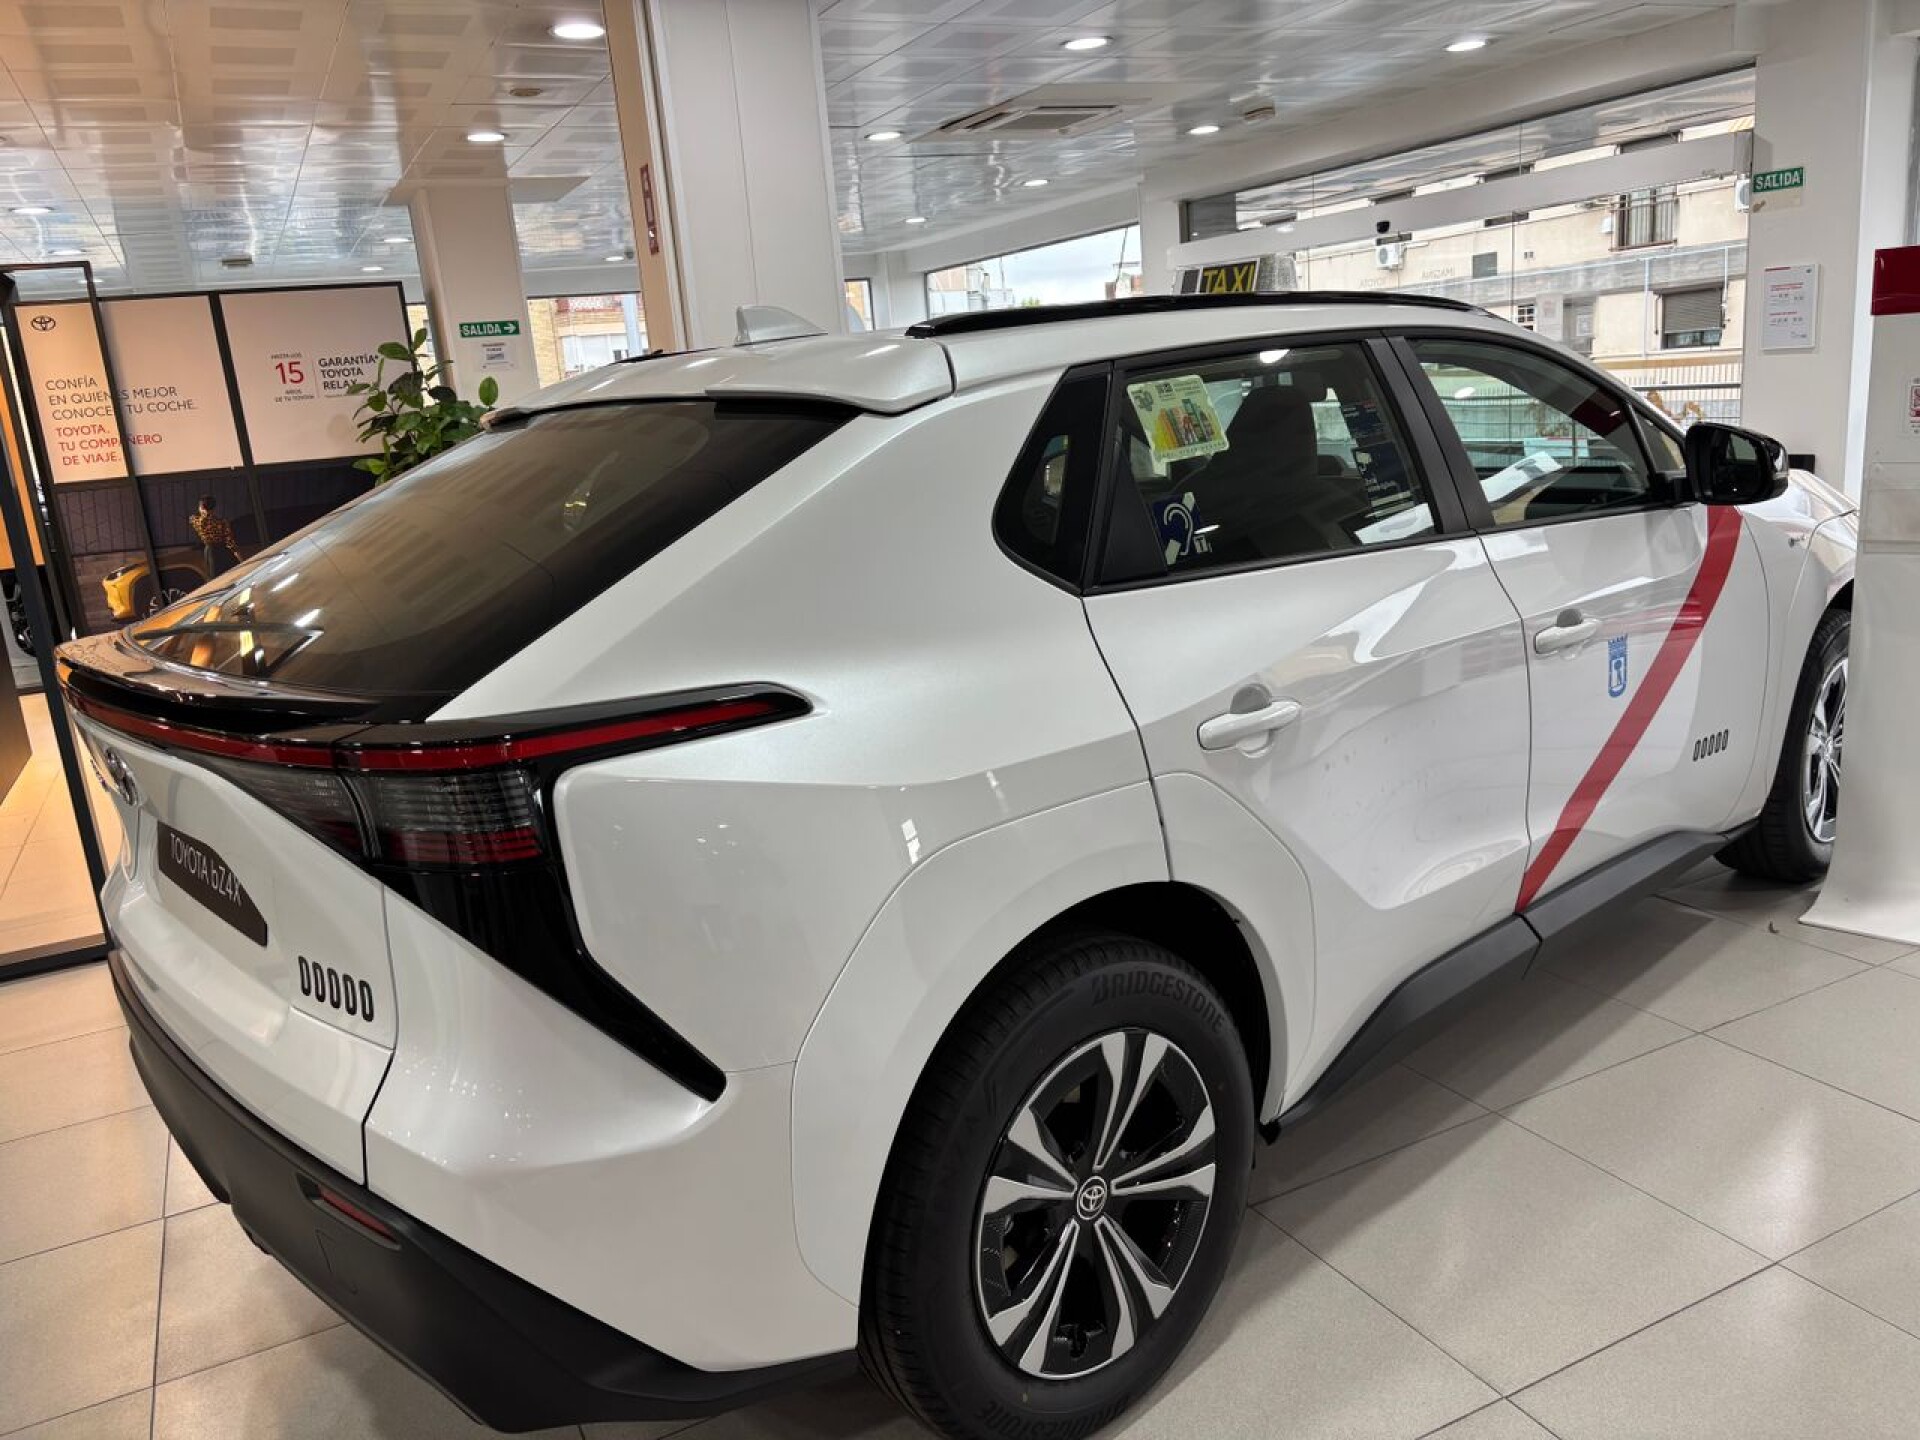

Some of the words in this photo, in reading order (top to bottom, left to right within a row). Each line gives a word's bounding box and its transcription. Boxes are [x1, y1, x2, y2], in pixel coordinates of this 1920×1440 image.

[1755, 171, 1801, 190] SALIDA
[1203, 264, 1255, 293] TAXI
[462, 324, 501, 336] SALIDA
[275, 361, 304, 384] 15
[321, 367, 364, 379] TOYOTA
[45, 375, 98, 391] CONFÍA
[48, 394, 67, 406] EN
[70, 390, 130, 404] QUIENS
[132, 386, 178, 400] MEJOR
[52, 406, 114, 420] CONOCE
[126, 404, 144, 415] TU
[59, 441, 76, 452] TU
[79, 433, 163, 451] COMPÑERO
[62, 455, 80, 466] DE
[170, 832, 210, 885] TOYOTA
[1092, 970, 1224, 1031] BRIDGESTONE
